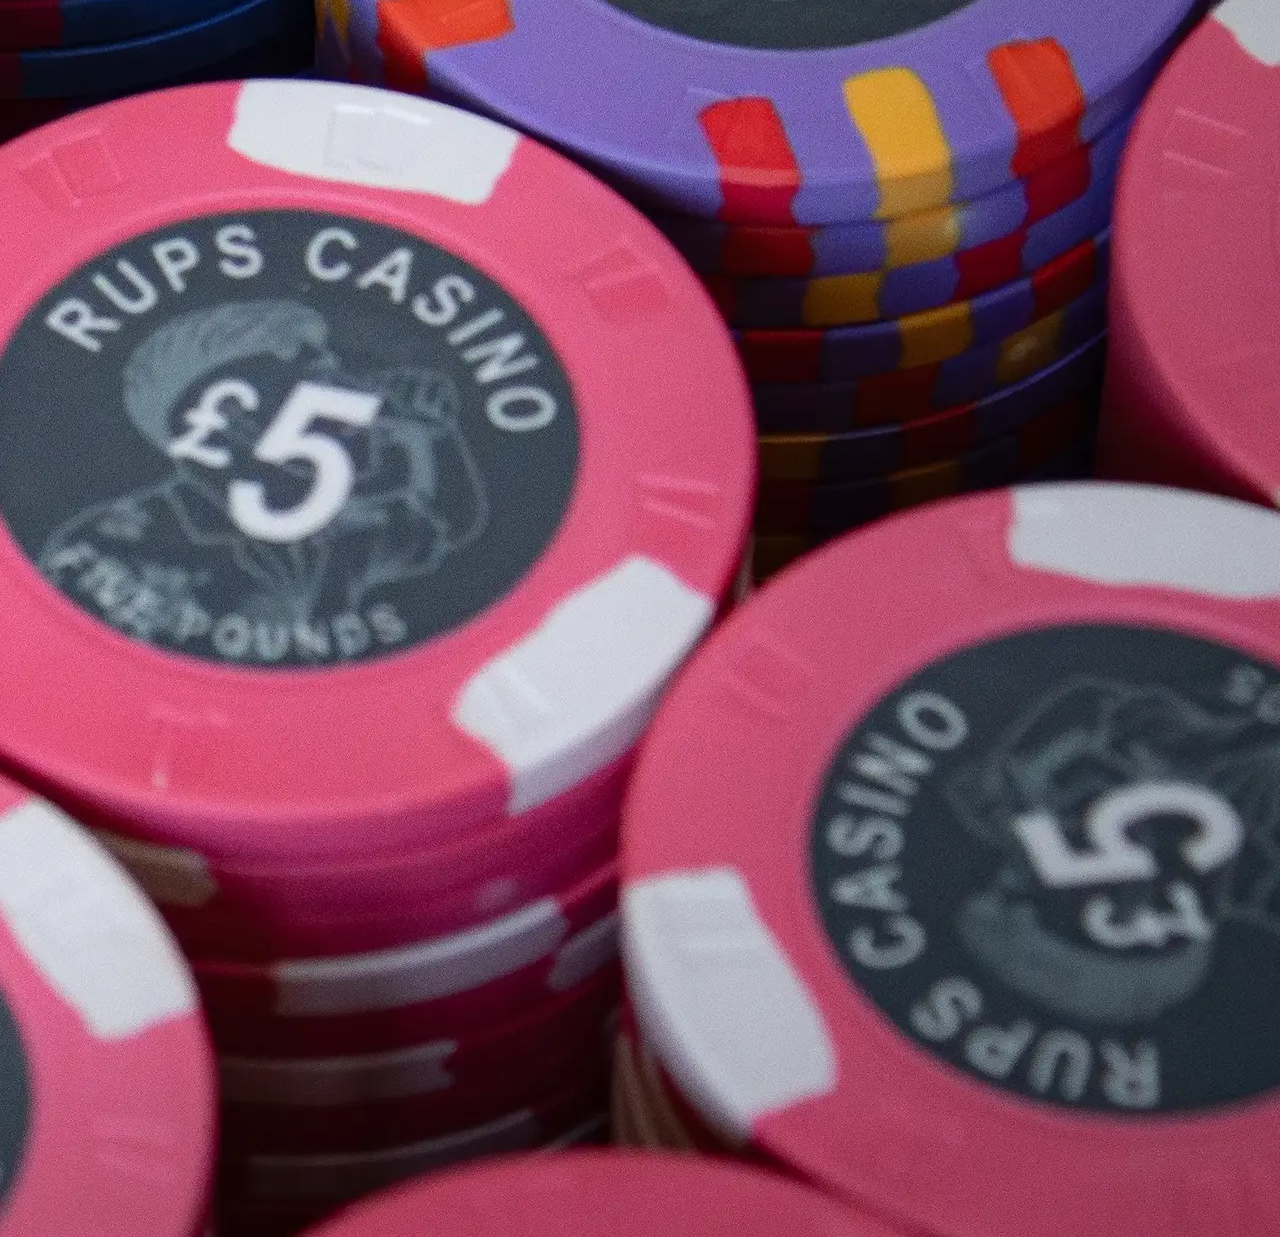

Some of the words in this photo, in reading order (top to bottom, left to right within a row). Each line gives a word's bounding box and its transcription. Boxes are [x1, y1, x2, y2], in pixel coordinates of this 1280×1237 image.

[44, 222, 265, 354] RUPS
[304, 226, 558, 432] CASINO
[166, 376, 385, 544] £5
[176, 601, 408, 662] POUNDS
[824, 689, 970, 970] CASINO
[1010, 778, 1248, 951] £5
[908, 974, 1163, 1110] RUPS
